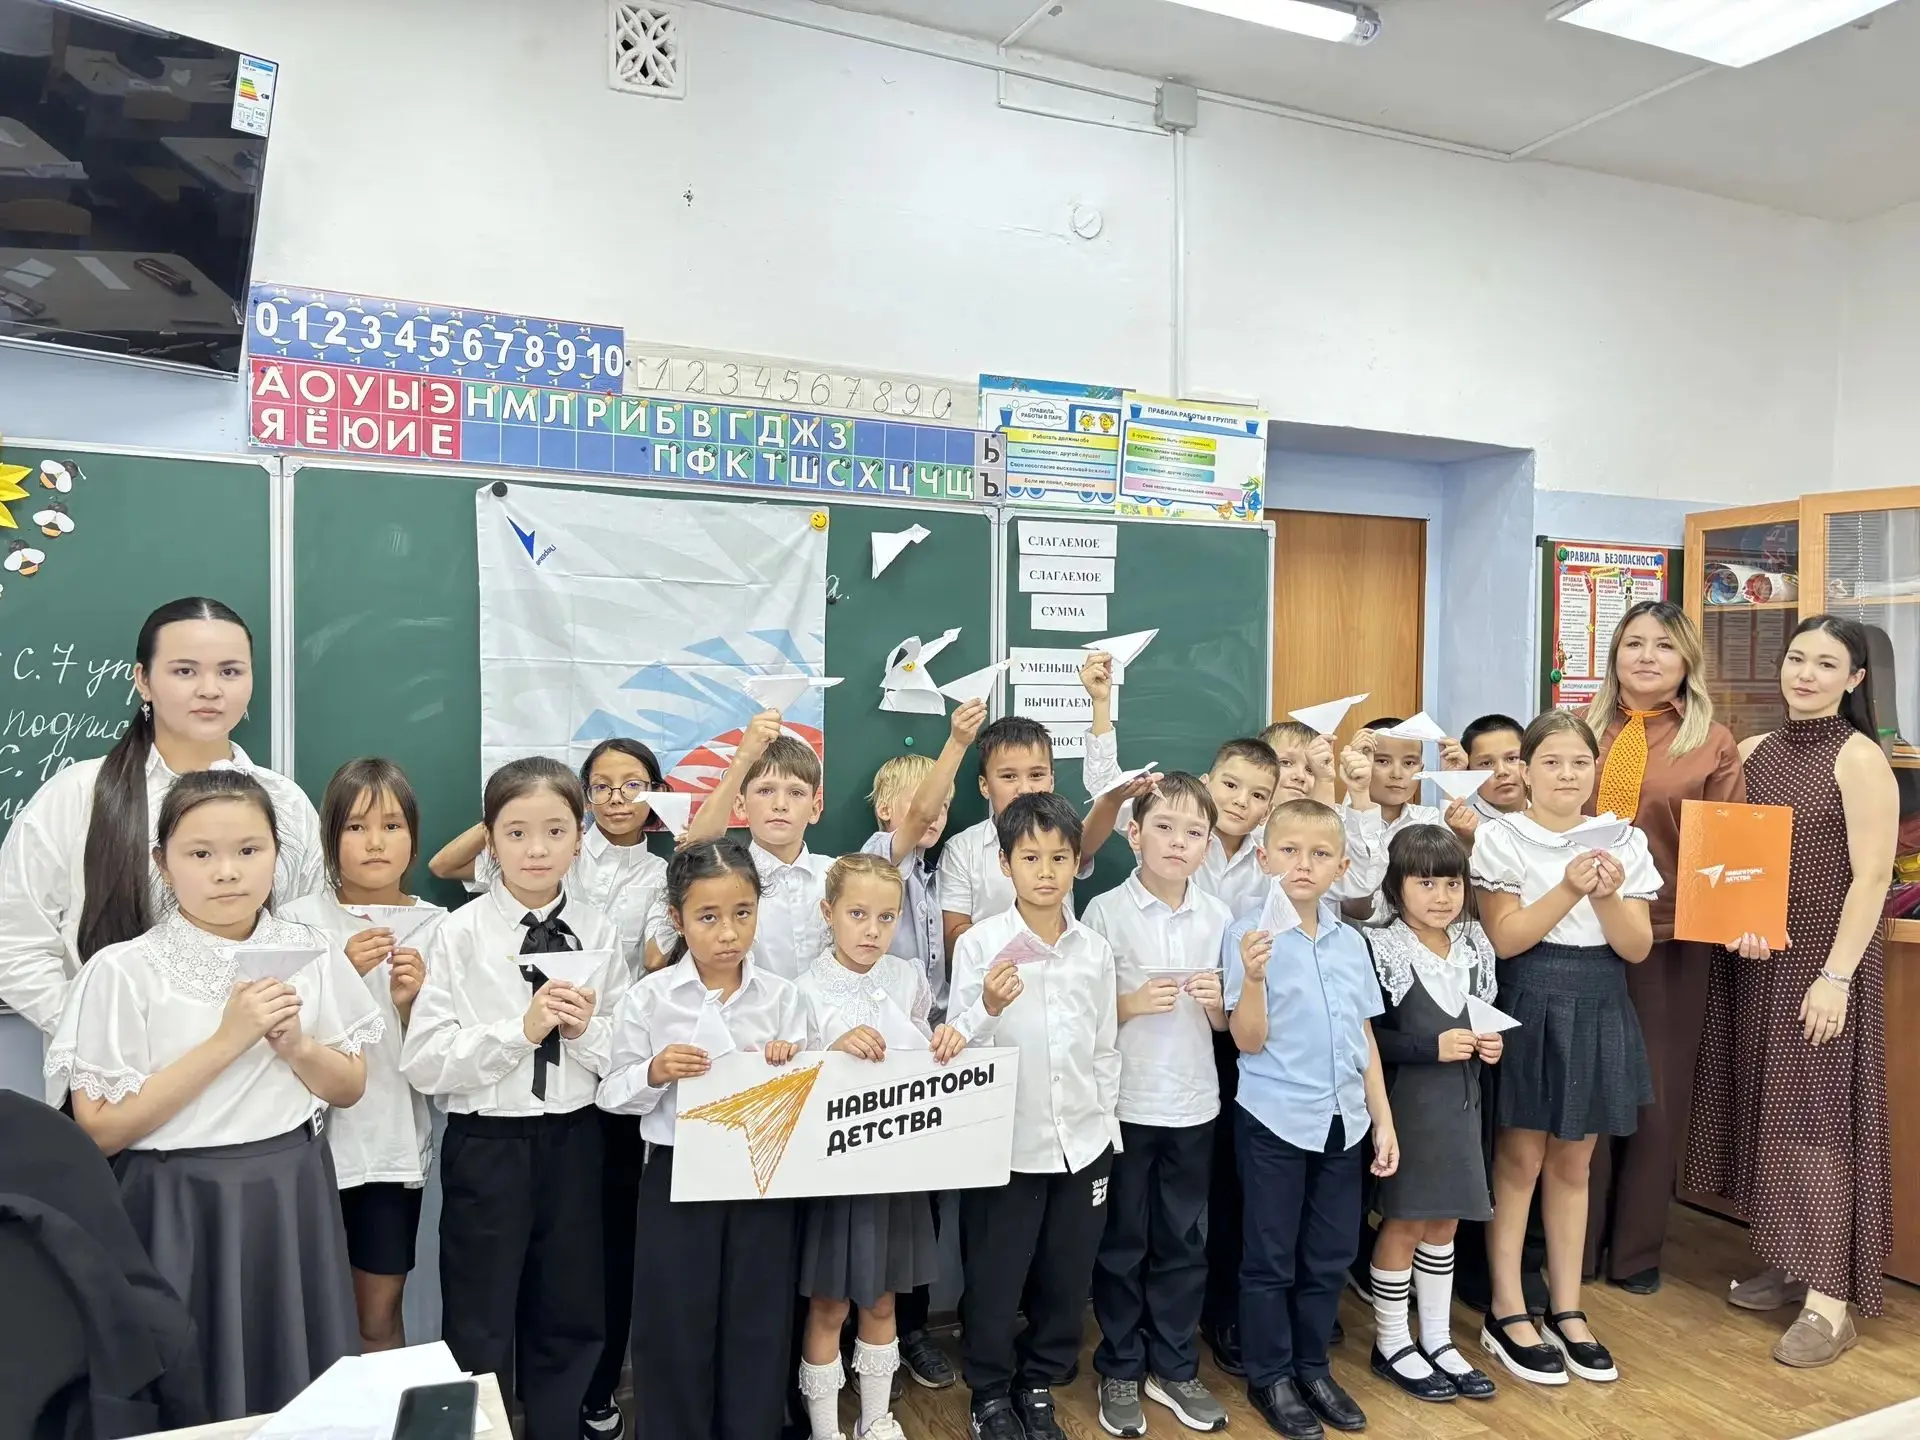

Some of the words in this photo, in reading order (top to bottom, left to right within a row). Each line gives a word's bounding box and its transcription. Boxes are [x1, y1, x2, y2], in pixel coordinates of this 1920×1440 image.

[255, 303, 278, 336] 0
[290, 305, 308, 341] 1
[325, 311, 347, 345] 2
[360, 316, 382, 349] 3
[395, 321, 417, 354] 4
[430, 325, 450, 357] 5
[462, 329, 483, 361] 6
[494, 332, 514, 363] 7
[525, 336, 544, 367] 8
[556, 339, 576, 371] 9
[586, 343, 623, 377] 10
[655, 358, 670, 390] 1
[685, 361, 705, 393] 2
[719, 364, 738, 395] 3
[755, 366, 771, 398] 4
[780, 369, 799, 400] 5
[811, 374, 830, 405] 6
[844, 377, 863, 408] 7
[872, 381, 892, 412] 8
[901, 384, 920, 415] 9
[933, 387, 951, 418] 0
[257, 366, 290, 398] А
[300, 371, 336, 403] О
[344, 376, 375, 406] У
[387, 379, 419, 411] Ы
[430, 383, 455, 413] Э
[468, 387, 494, 417] Н
[503, 392, 536, 421] М
[545, 395, 571, 424] Л
[588, 398, 607, 427] Р
[621, 401, 646, 432] Й
[656, 407, 676, 435] Б
[694, 410, 712, 438] В
[730, 412, 746, 439] Г
[758, 416, 784, 447] Д
[791, 419, 819, 447] Ж
[829, 423, 847, 450] З
[984, 438, 999, 463] Ь
[1148, 407, 1178, 417] ПРАВИЛА
[1179, 411, 1206, 420] РАБОТЫ
[1213, 416, 1238, 425] ГРУППЕ
[260, 408, 284, 440] Я
[306, 409, 328, 445] Ё
[344, 417, 380, 448] Ю
[388, 422, 415, 452] И
[432, 425, 452, 455] Е
[654, 444, 677, 473] П
[687, 447, 716, 474] Ф
[727, 451, 749, 478] К
[763, 453, 782, 481] Т
[790, 456, 818, 483] Ш
[827, 460, 846, 486] С
[859, 463, 882, 488] Х
[890, 466, 911, 494] Ц
[920, 468, 939, 493] Ч
[946, 470, 974, 499] Щ
[980, 473, 999, 496] Ъ
[1028, 536, 1100, 549] СЛАГАЕМОЕ
[1029, 569, 1101, 582] СЛАГАЕМОЕ
[1041, 606, 1085, 617] СУММА
[52, 644, 78, 684] 7
[1020, 662, 1085, 673] УМЕНЬША
[1024, 697, 1093, 708] ВЫЧИТАЕМ
[1051, 737, 1084, 746] НОСТ
[826, 1063, 995, 1122] НАВИГАТОРЫ
[826, 1107, 942, 1156] ДЕТСТВА
